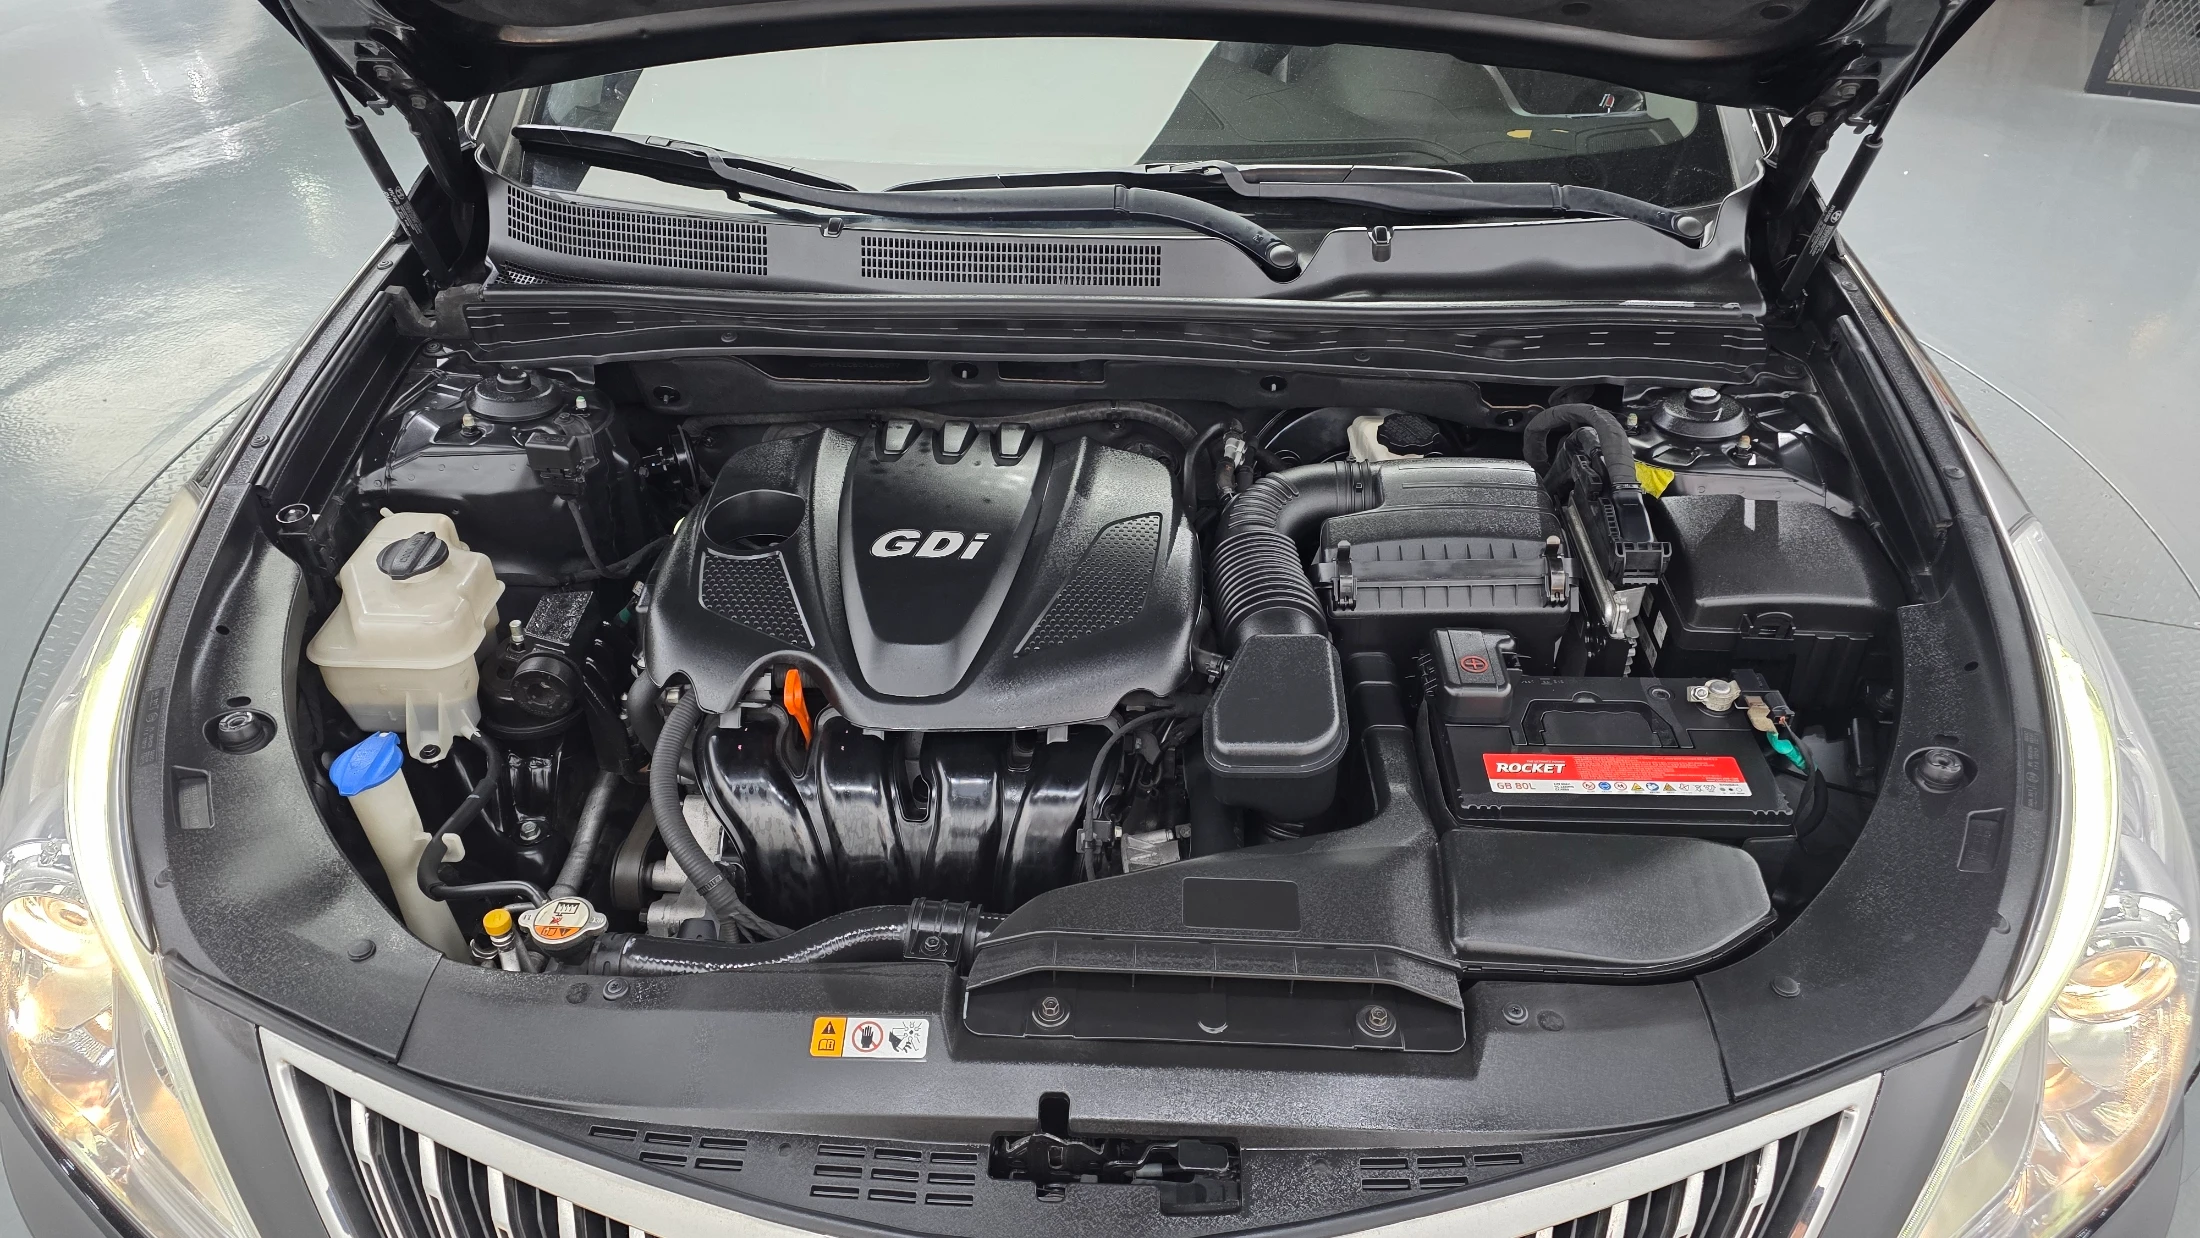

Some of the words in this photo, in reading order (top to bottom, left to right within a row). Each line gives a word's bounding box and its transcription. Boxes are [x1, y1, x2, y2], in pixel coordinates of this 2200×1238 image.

[869, 528, 991, 560] GDi
[1495, 762, 1566, 774] ROCKET
[1496, 782, 1512, 790] GB
